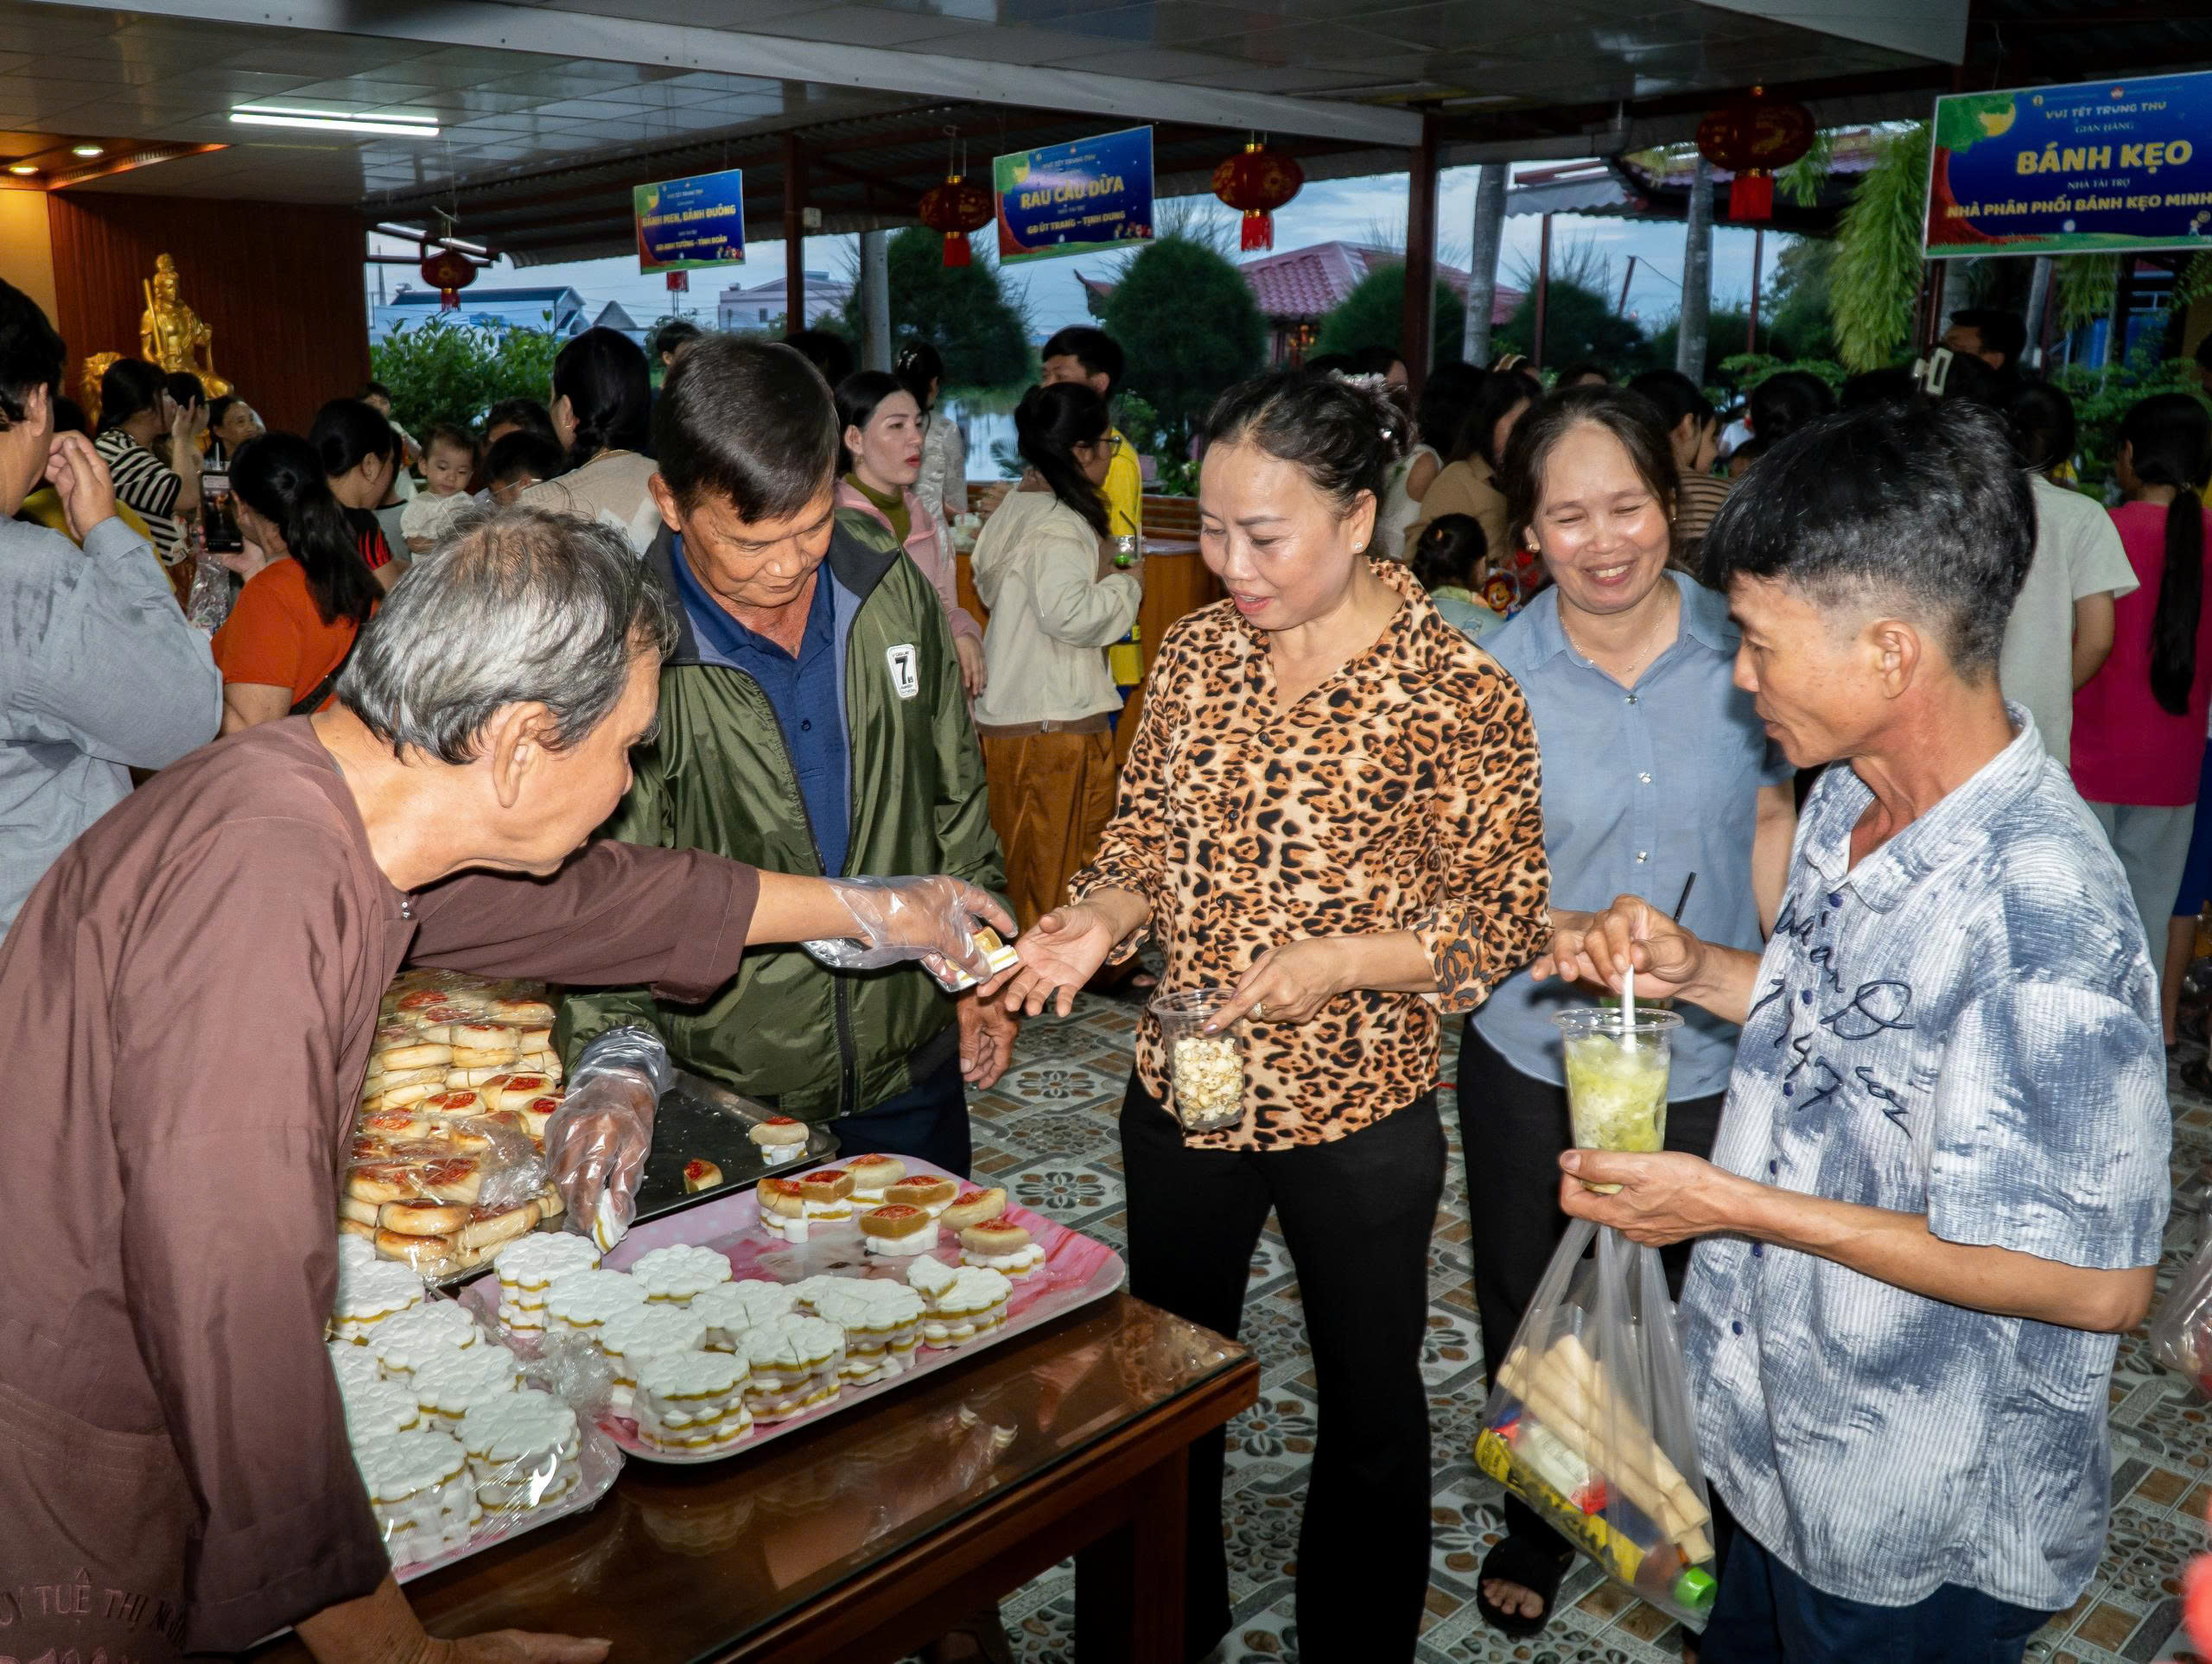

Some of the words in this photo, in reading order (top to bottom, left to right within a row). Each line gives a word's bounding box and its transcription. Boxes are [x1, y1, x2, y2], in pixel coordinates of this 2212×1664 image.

[2046, 107, 2068, 120] VUI
[2071, 104, 2092, 118] TẾT
[2095, 103, 2138, 116] TRUNG
[2141, 100, 2168, 113] THU
[2016, 141, 2111, 175] BÁNH
[2120, 139, 2194, 175] KẸO
[1020, 189, 1051, 208] RAU
[1947, 200, 1981, 219] NHÀ
[1984, 198, 2028, 216] PHÂN
[2031, 193, 2072, 214] PHỐI
[2074, 194, 2123, 212] BÁNH
[2126, 194, 2162, 213] KẸO
[2164, 191, 2212, 208] MINH
[35, 1566, 92, 1626] TUỆ
